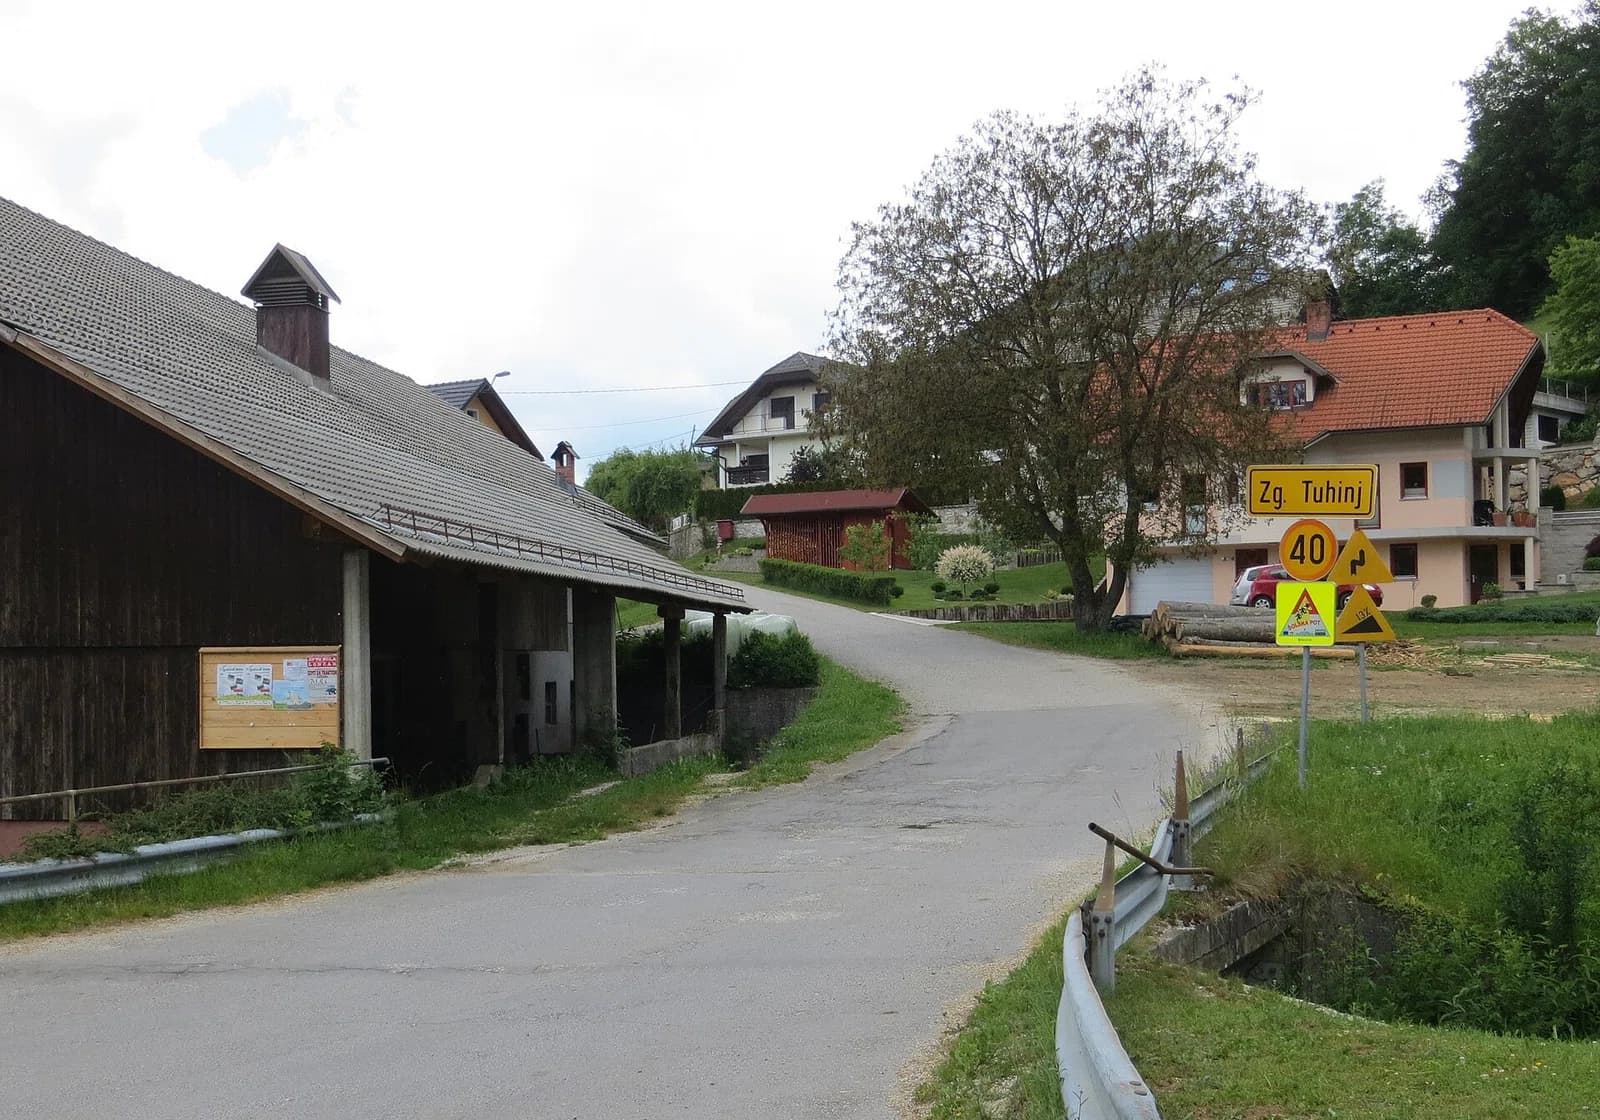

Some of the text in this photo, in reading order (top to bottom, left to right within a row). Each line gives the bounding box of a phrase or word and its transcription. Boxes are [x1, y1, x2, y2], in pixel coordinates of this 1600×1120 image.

[1259, 480, 1363, 510] Zg. Tuhinj
[1289, 534, 1325, 565] 40
[1355, 607, 1371, 620] 13%
